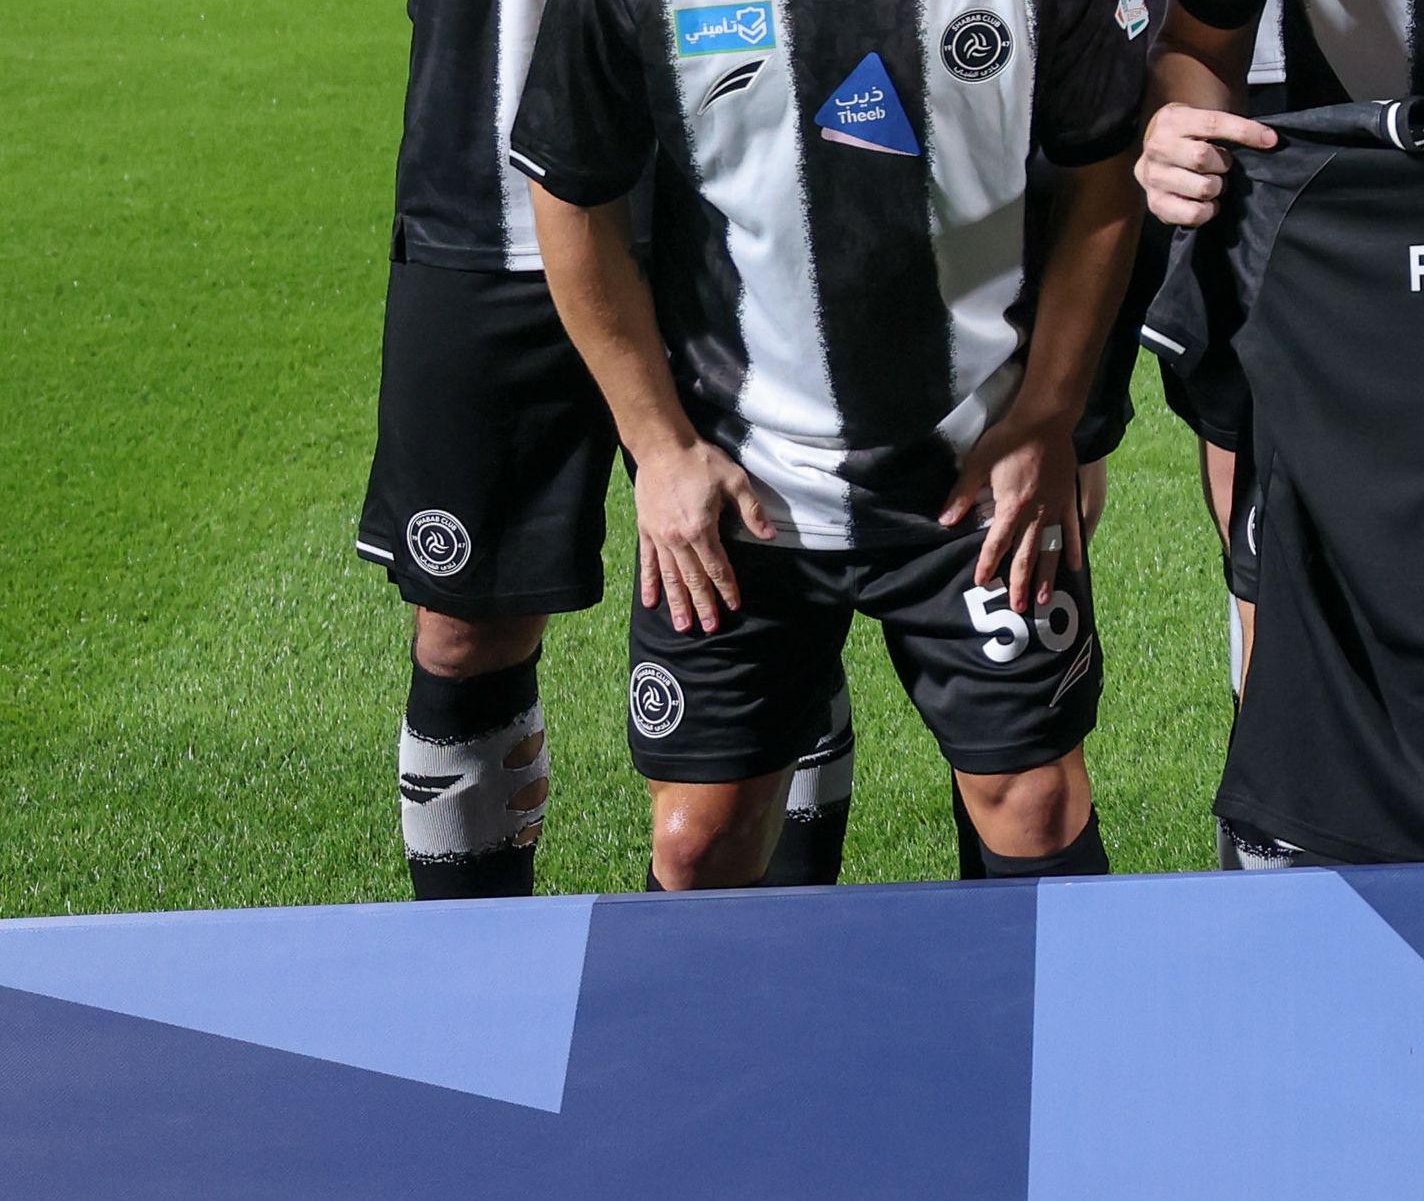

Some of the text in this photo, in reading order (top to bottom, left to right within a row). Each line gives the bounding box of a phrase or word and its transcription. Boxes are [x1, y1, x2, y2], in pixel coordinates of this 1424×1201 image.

[952, 14, 1002, 32] SHABAB CLUB
[835, 86, 884, 109] ذيب
[837, 106, 886, 124] Theeb
[415, 516, 457, 532] SHABAB CLUB
